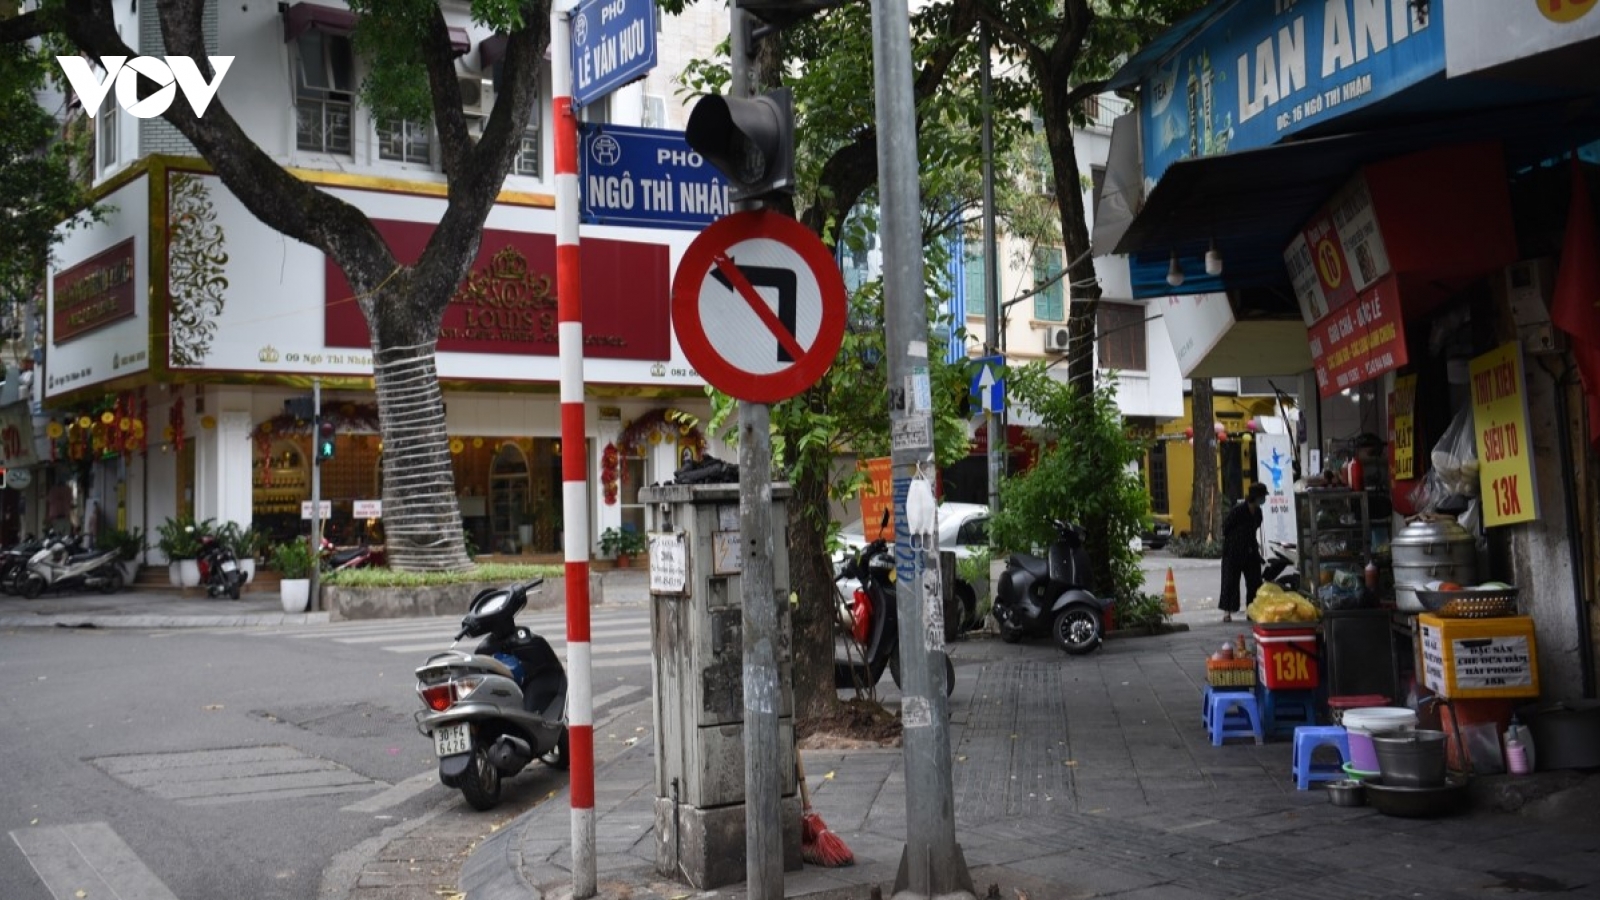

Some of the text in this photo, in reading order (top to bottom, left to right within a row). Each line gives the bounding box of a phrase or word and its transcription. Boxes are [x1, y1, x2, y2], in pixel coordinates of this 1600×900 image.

[579, 45, 591, 89] LÊ
[594, 34, 617, 80] VĂN
[1237, 16, 1307, 124] LAN
[1293, 105, 1302, 122] 16
[589, 171, 634, 210] NGÔ
[640, 173, 674, 213] THÌ
[466, 308, 533, 330] LOUIS
[285, 352, 300, 362] 09
[303, 353, 323, 365] Ngô
[1505, 423, 1519, 457] TO
[1492, 475, 1522, 518] 13K
[1272, 651, 1310, 681] 13K
